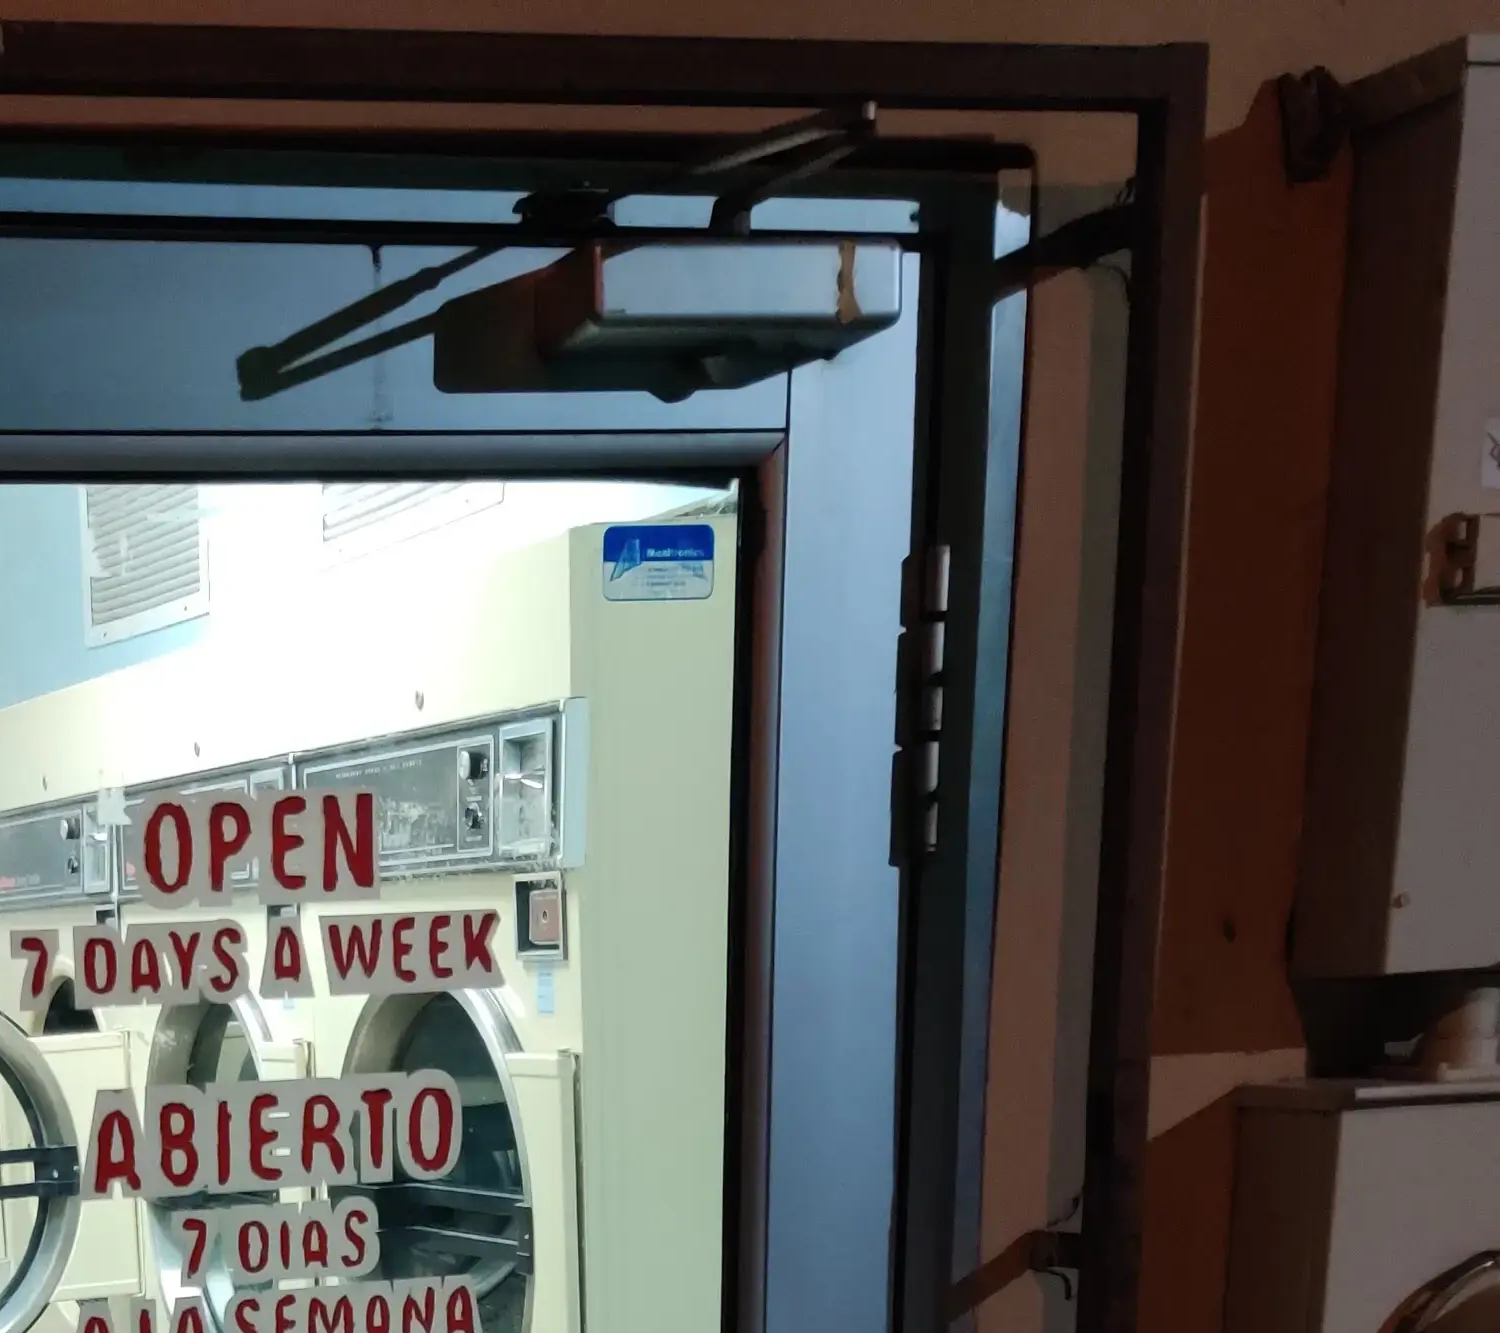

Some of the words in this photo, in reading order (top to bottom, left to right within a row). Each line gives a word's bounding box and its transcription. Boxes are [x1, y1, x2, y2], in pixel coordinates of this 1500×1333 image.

[143, 792, 375, 895] OPEN
[19, 936, 49, 999] 7
[83, 926, 242, 995] DAYS
[273, 925, 303, 982] A
[327, 911, 499, 982] WEEK
[93, 1086, 455, 1194] ABIERTO
[182, 1217, 207, 1280] 7
[237, 1209, 369, 1275] DIAS
